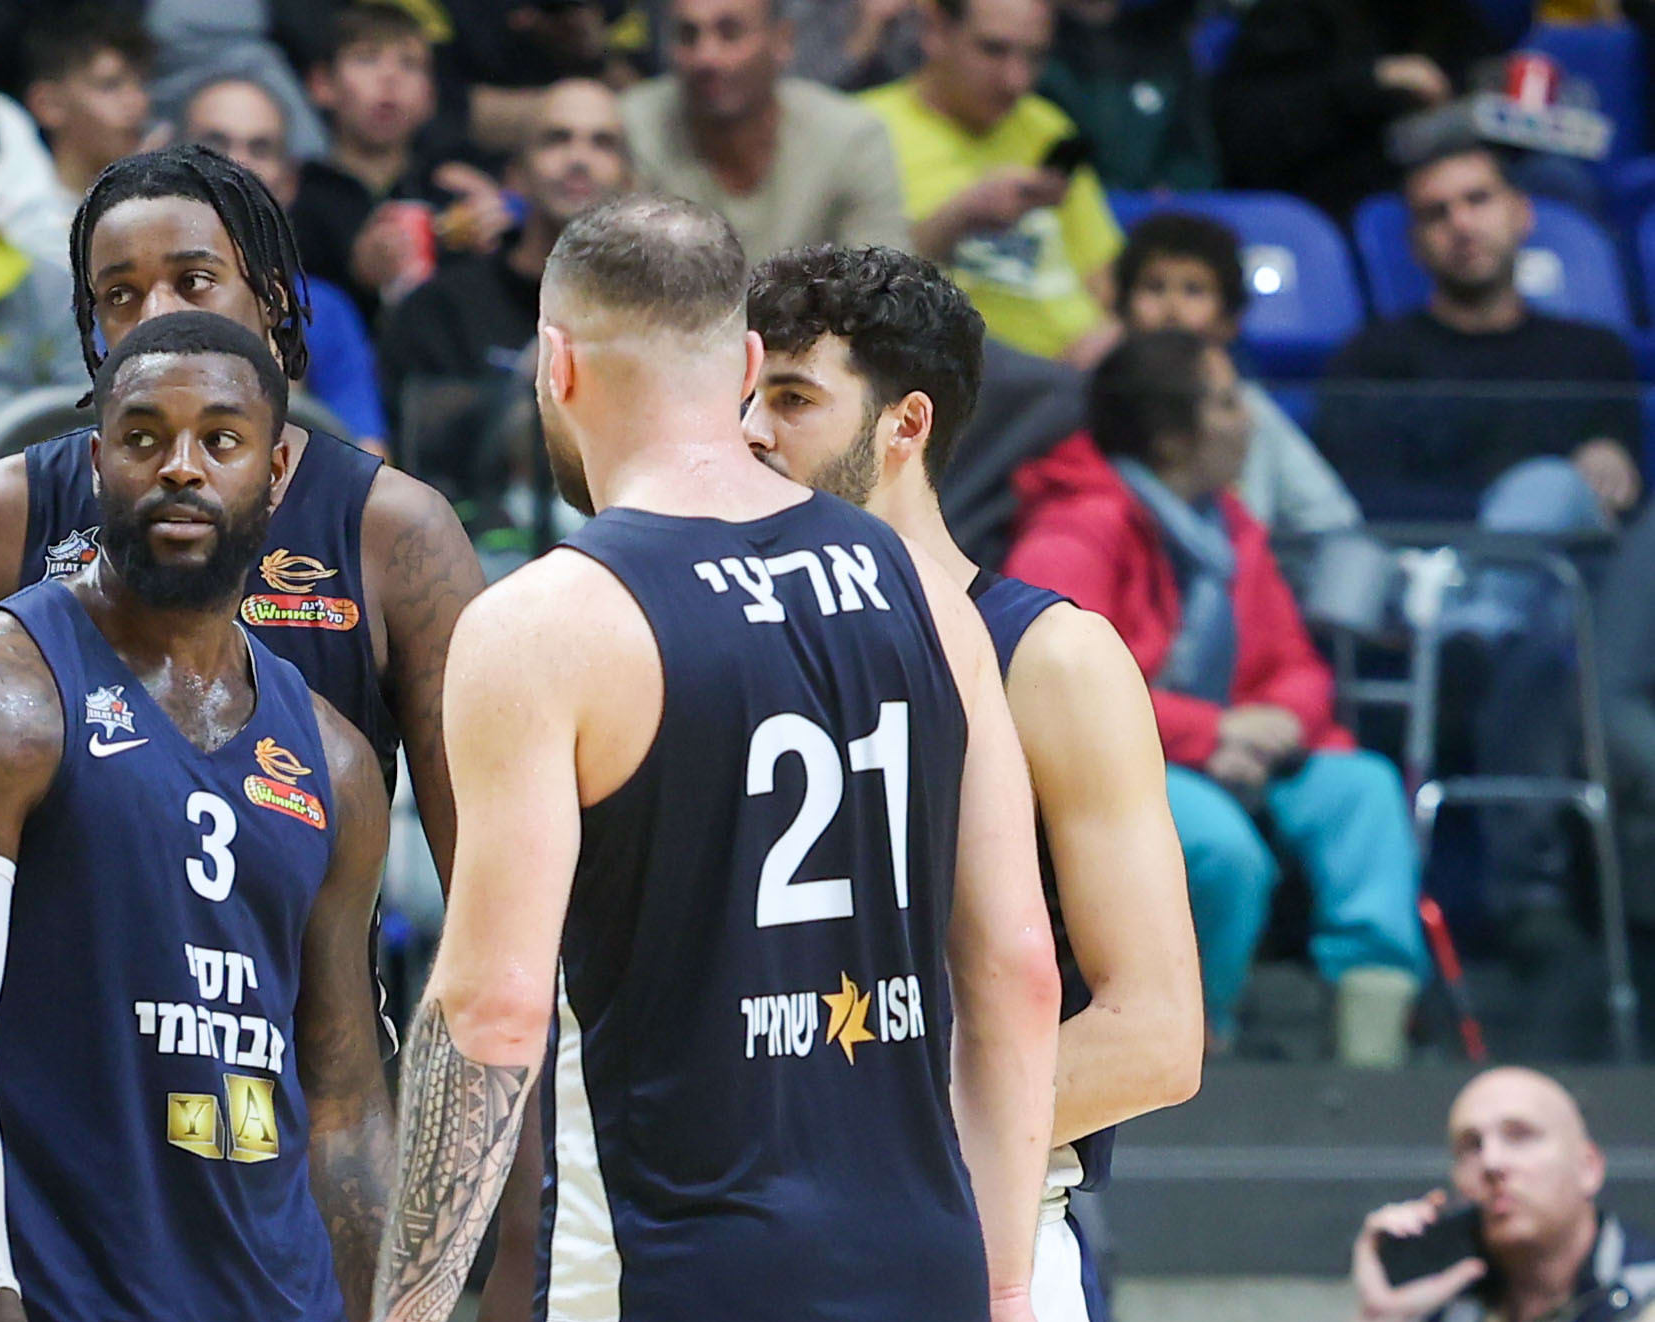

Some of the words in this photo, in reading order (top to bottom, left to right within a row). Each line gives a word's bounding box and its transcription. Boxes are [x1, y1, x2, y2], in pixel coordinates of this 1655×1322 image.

[256, 603, 326, 621] Winner
[693, 544, 891, 623] ארצי
[185, 791, 238, 902] 3
[746, 700, 909, 929] 21
[184, 943, 259, 1004] יוסי
[134, 1001, 286, 1075] אברהמי
[172, 1100, 211, 1136] Y
[236, 1084, 275, 1142] A
